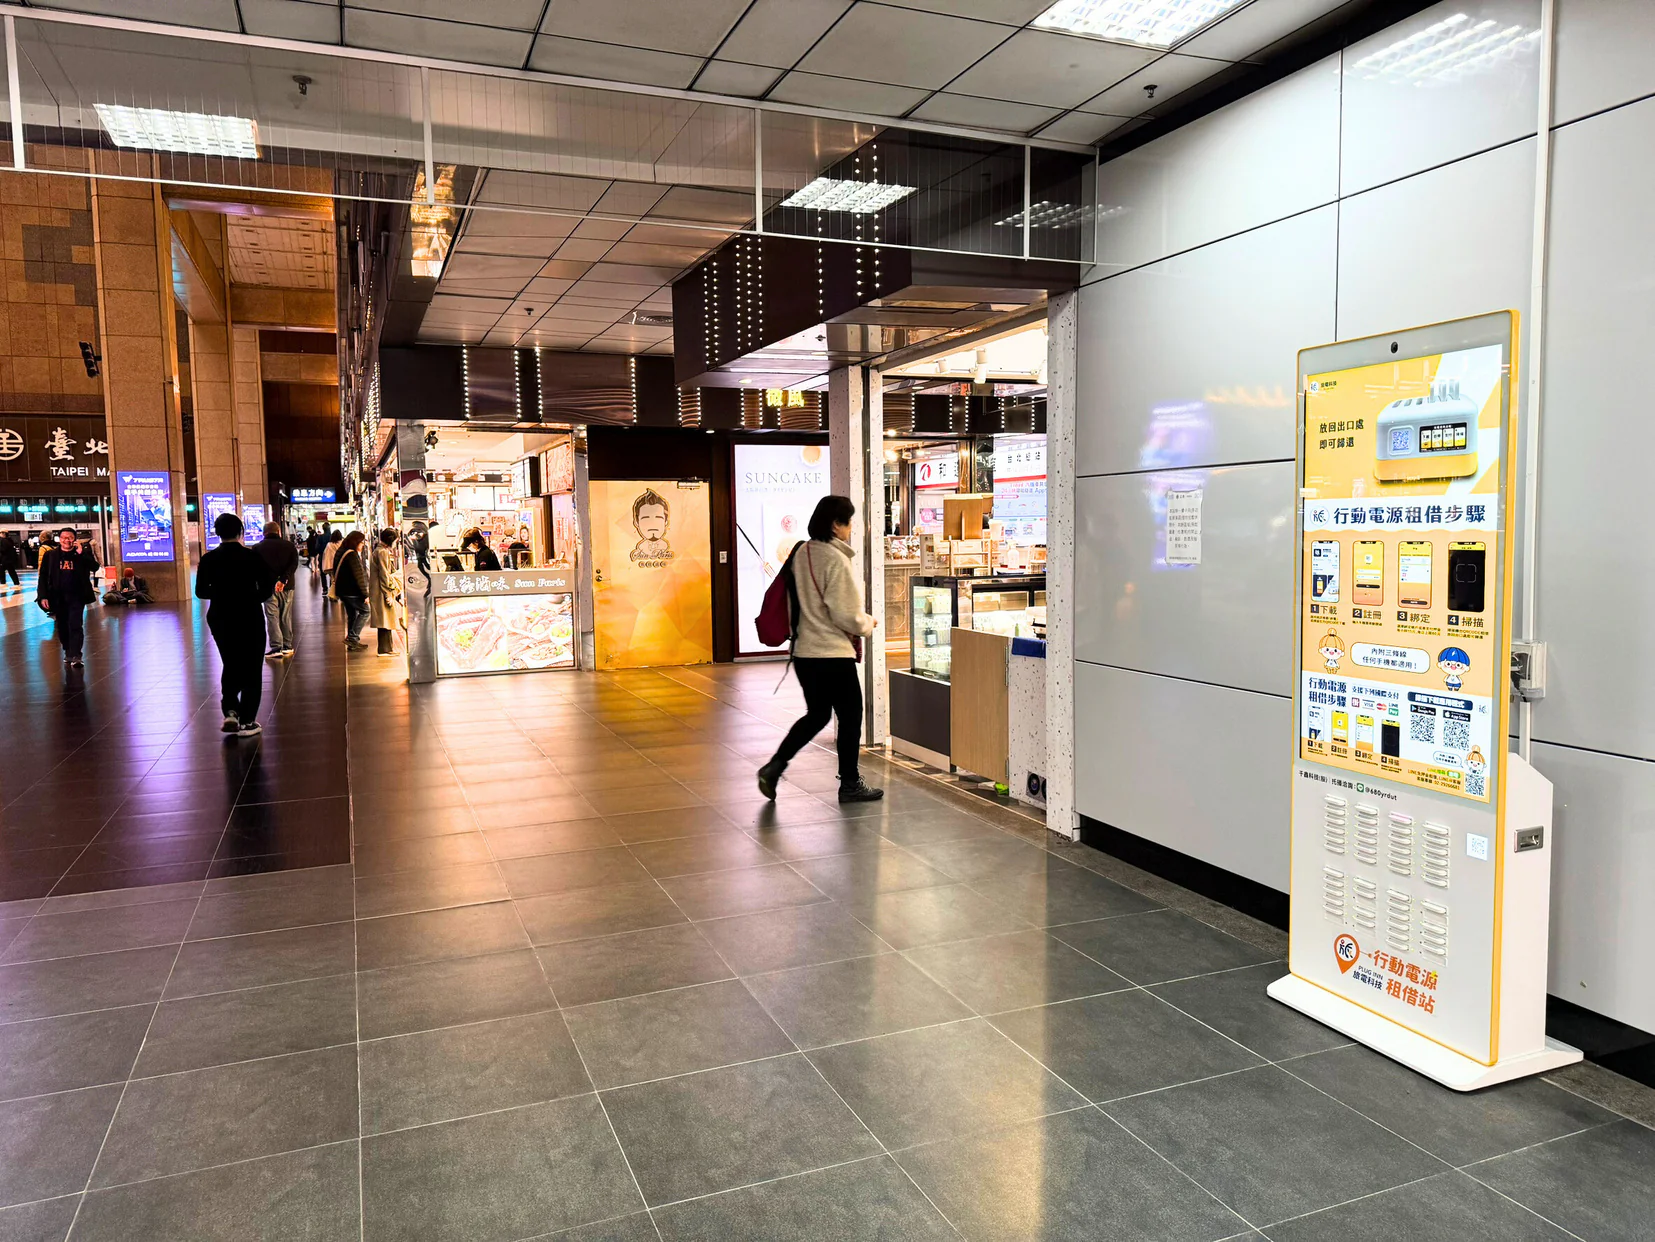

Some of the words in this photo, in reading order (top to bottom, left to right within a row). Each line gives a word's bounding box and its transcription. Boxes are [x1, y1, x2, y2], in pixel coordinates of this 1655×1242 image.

[766, 388, 805, 407] 微風
[1319, 418, 1364, 433] 放回出口處
[44, 426, 108, 461] 臺北
[1319, 436, 1354, 449] 即可歸還
[50, 466, 89, 477] TAIPEI
[745, 472, 822, 484] SUNCAKE
[1334, 504, 1486, 525] 行動電源租借步驟
[514, 578, 536, 588] Sun
[537, 577, 566, 587] Paris
[1320, 605, 1338, 615] 下載
[1461, 616, 1484, 628] 掃描
[1308, 676, 1347, 694] 行動電源
[1308, 690, 1347, 708] 租借步驟
[1358, 965, 1372, 976] PLUG
[1373, 949, 1439, 991] 行動電源
[1386, 978, 1436, 1014] 租借站
